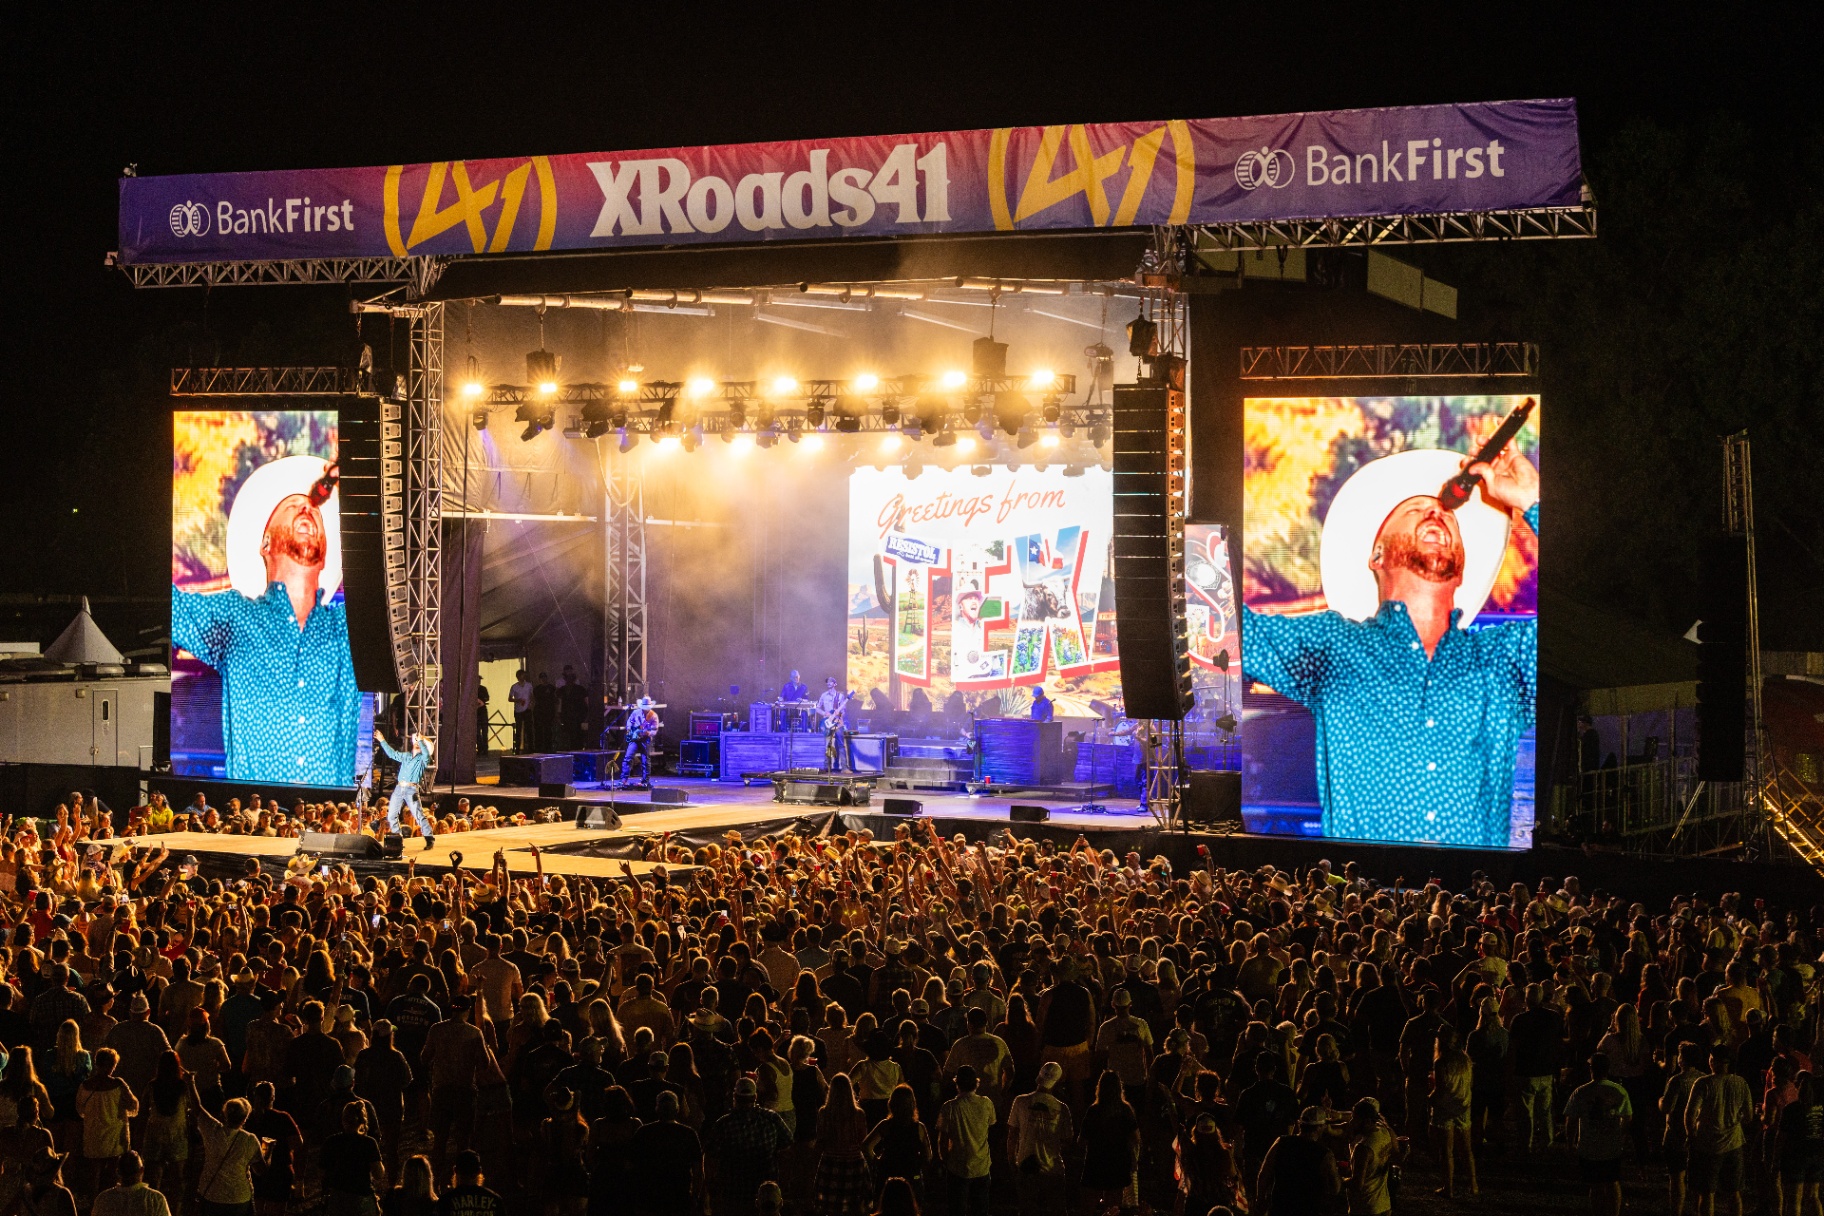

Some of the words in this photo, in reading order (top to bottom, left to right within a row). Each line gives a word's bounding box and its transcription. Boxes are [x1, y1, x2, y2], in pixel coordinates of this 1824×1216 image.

[586, 142, 952, 238] XRoads41
[1307, 137, 1505, 186] BankFirst
[217, 196, 354, 235] BankFirst
[877, 491, 994, 540] Greetings
[996, 479, 1066, 525] from
[879, 525, 1241, 690] TEXS
